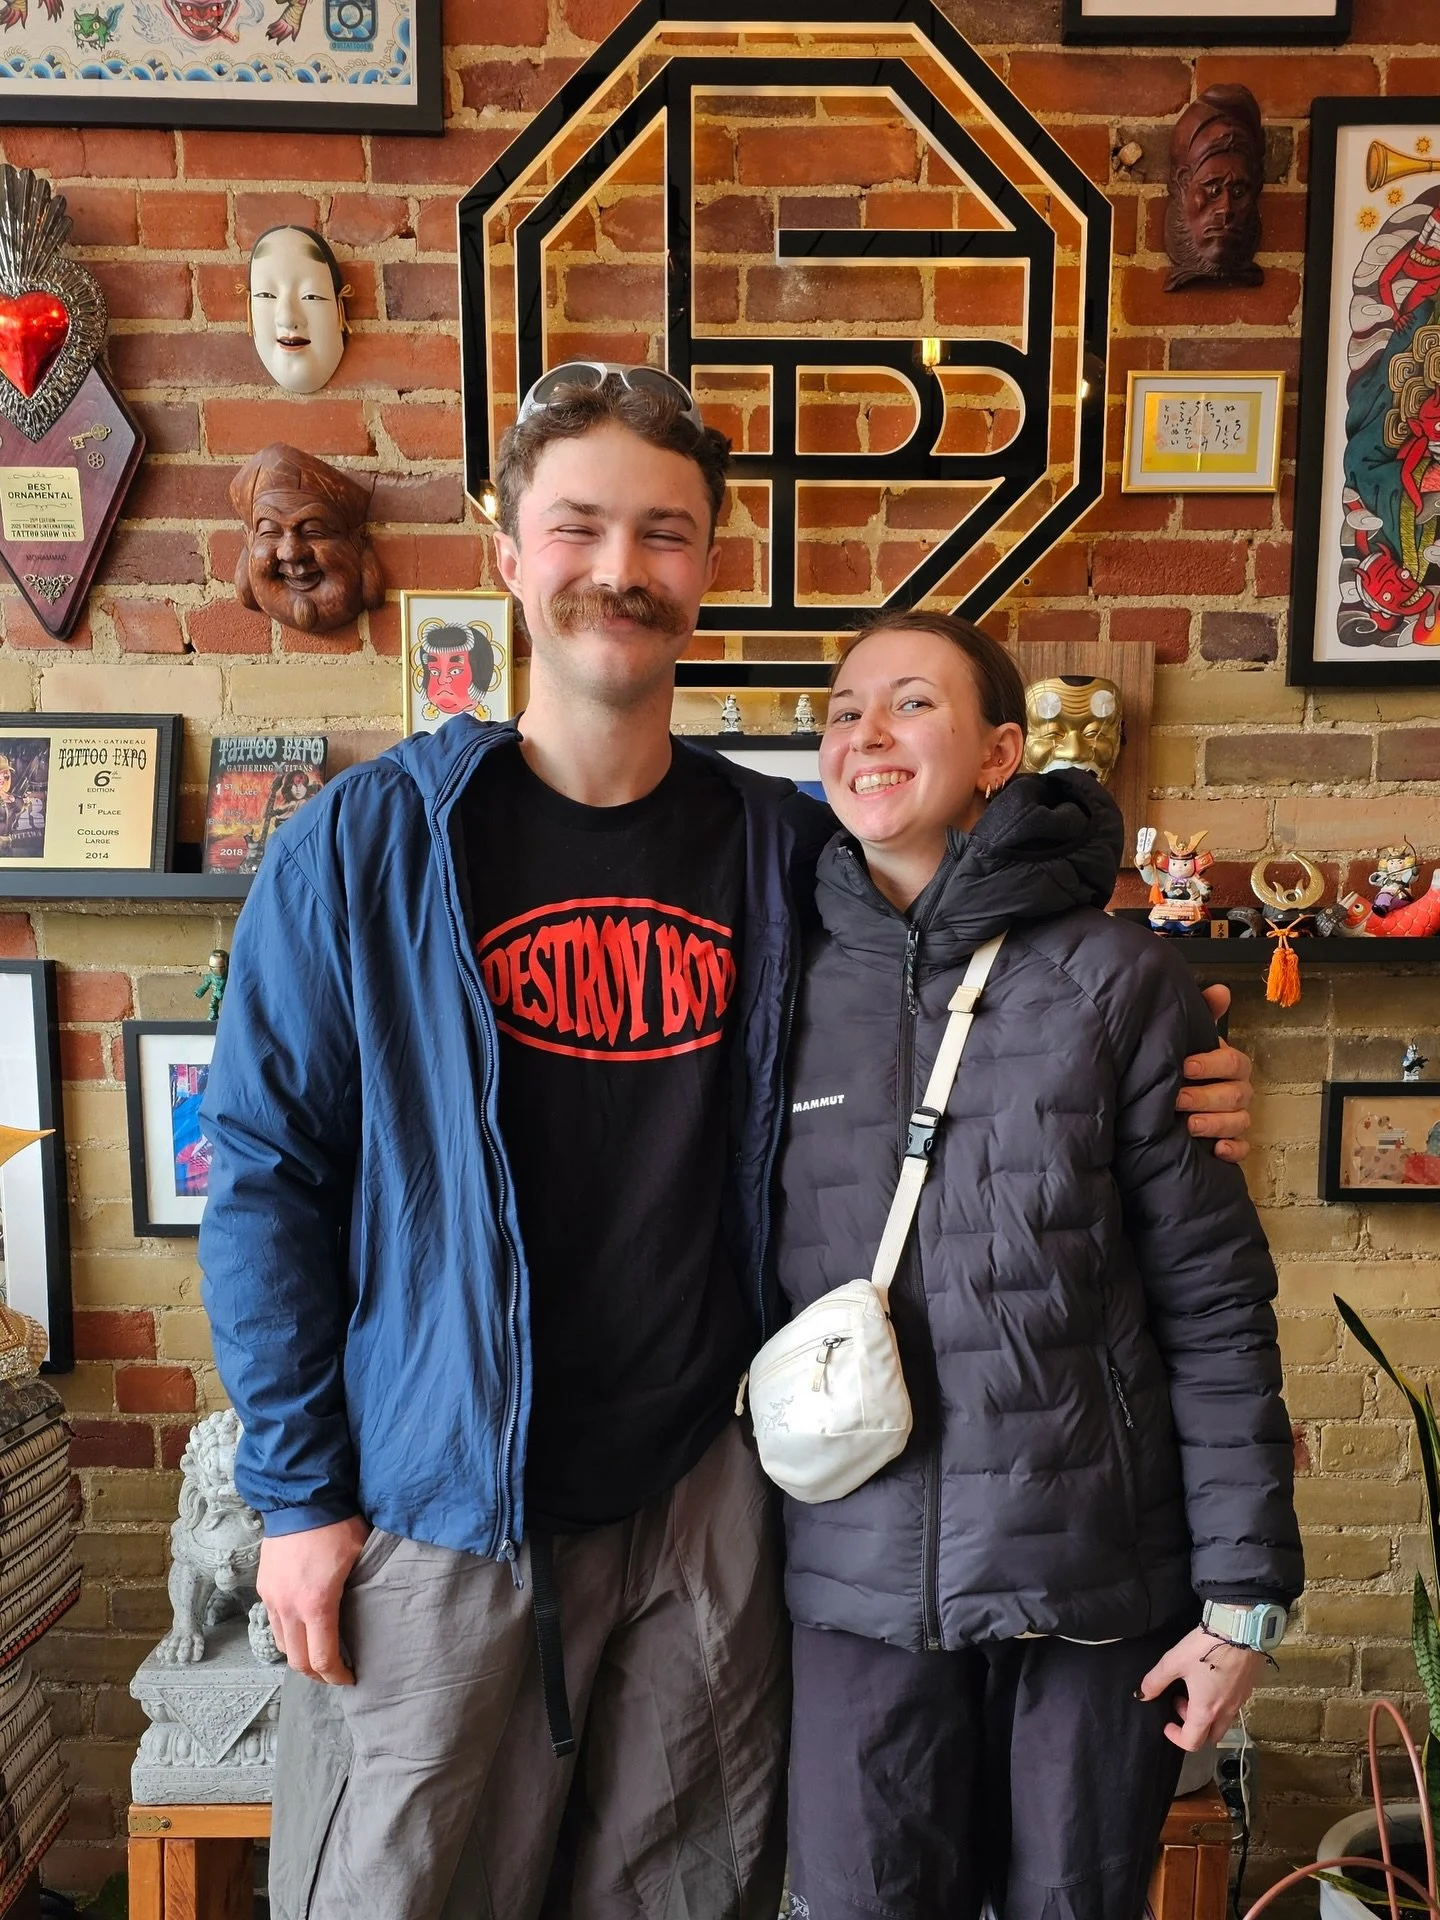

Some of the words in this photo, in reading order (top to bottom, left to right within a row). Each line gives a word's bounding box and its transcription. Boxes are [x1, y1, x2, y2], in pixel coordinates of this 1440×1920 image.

[27, 483, 52, 491] BEST
[8, 491, 73, 499] ORNAMENTAL
[12, 530, 39, 538] TATTOO
[40, 530, 60, 538] SHOW
[282, 737, 325, 765] EXPO
[112, 748, 147, 770] EXPO
[226, 764, 274, 772] GATHERING
[284, 764, 314, 772] TITANS
[77, 828, 120, 836] COLOURS
[220, 848, 244, 856] 2018
[481, 915, 650, 1048] DESTROY
[792, 1094, 845, 1113] MAMMUT
